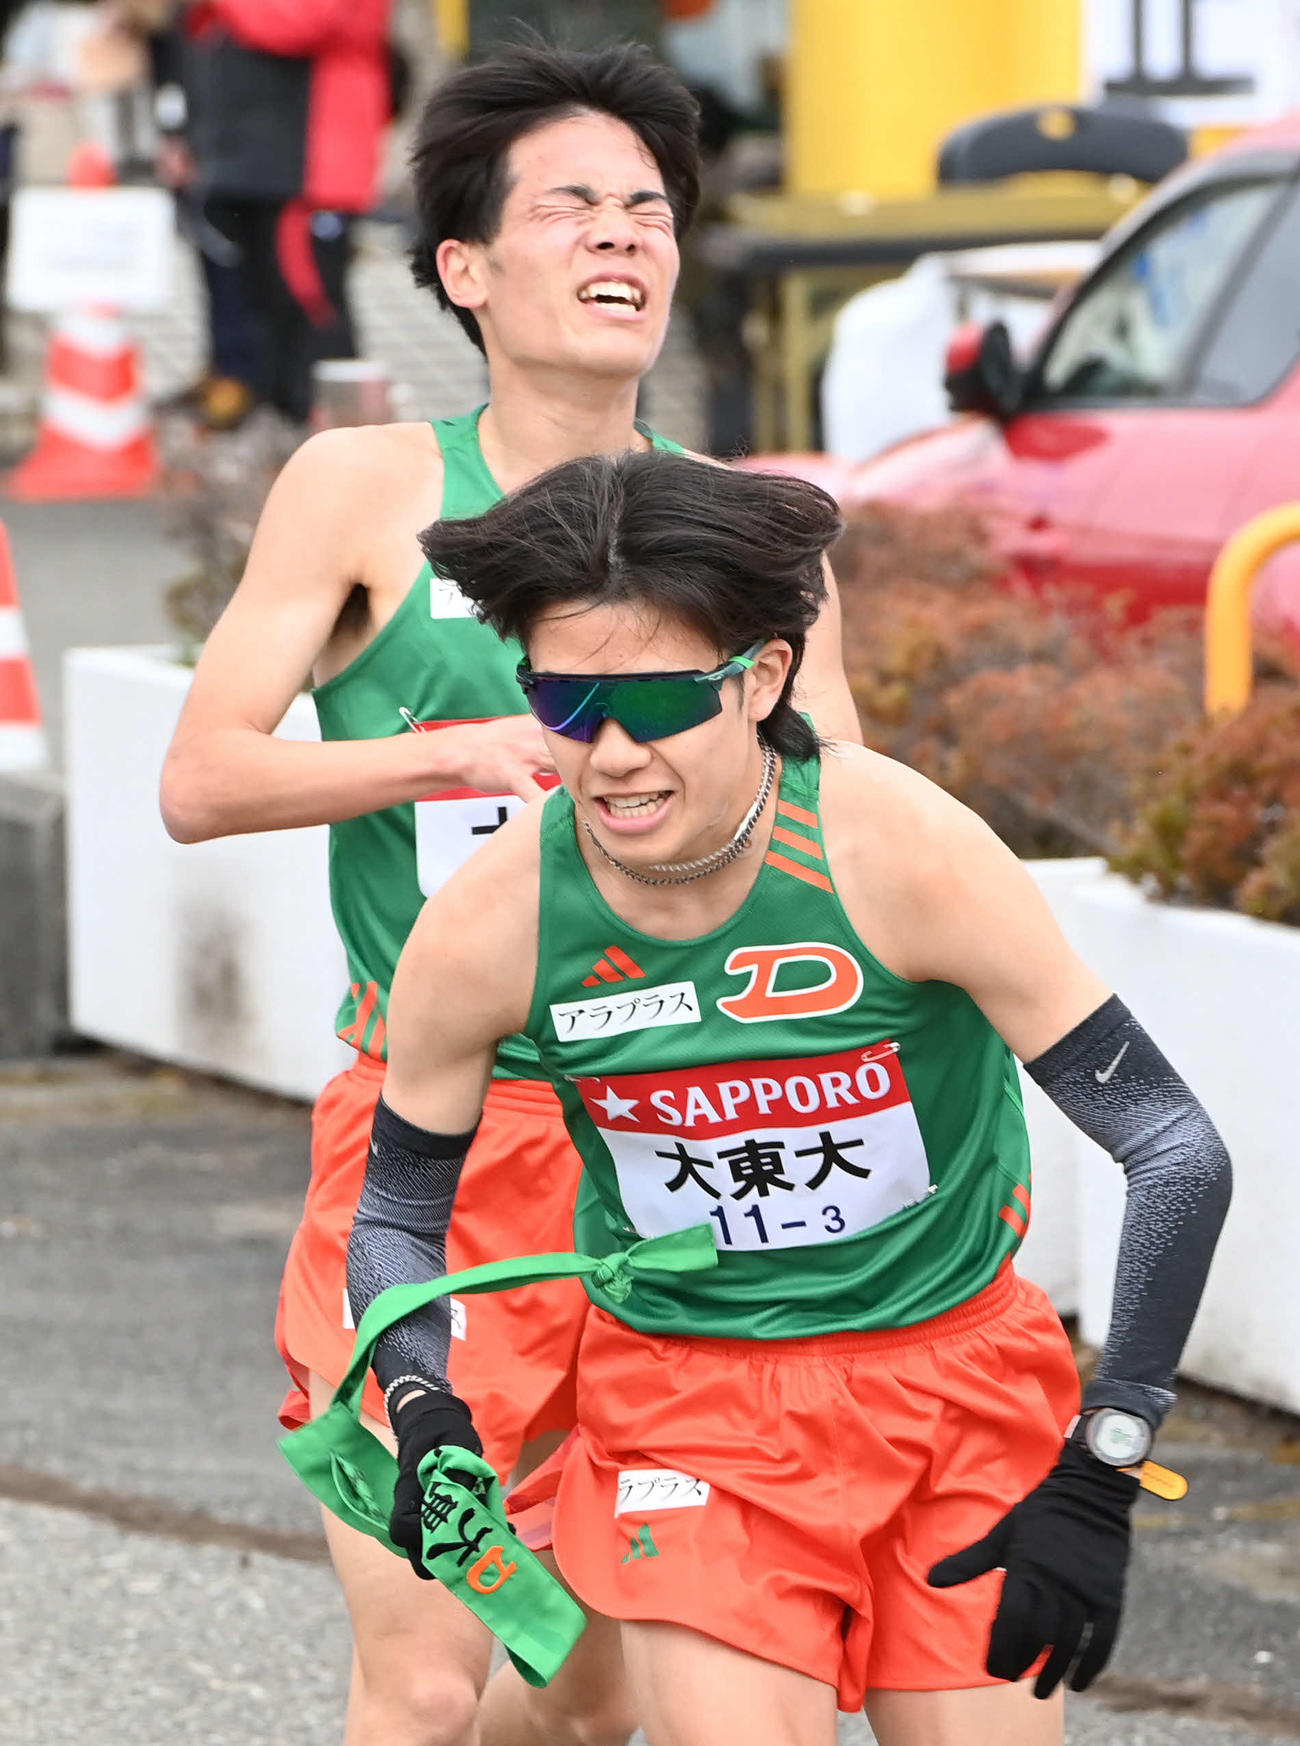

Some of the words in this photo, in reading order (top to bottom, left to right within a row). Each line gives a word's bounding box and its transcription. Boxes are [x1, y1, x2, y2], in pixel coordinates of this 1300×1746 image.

[558, 992, 693, 1034] アラプラス
[716, 942, 864, 1024] D
[649, 1061, 892, 1127] SAPPORO
[654, 1130, 872, 1201] 大東大
[709, 1204, 846, 1245] 11-3
